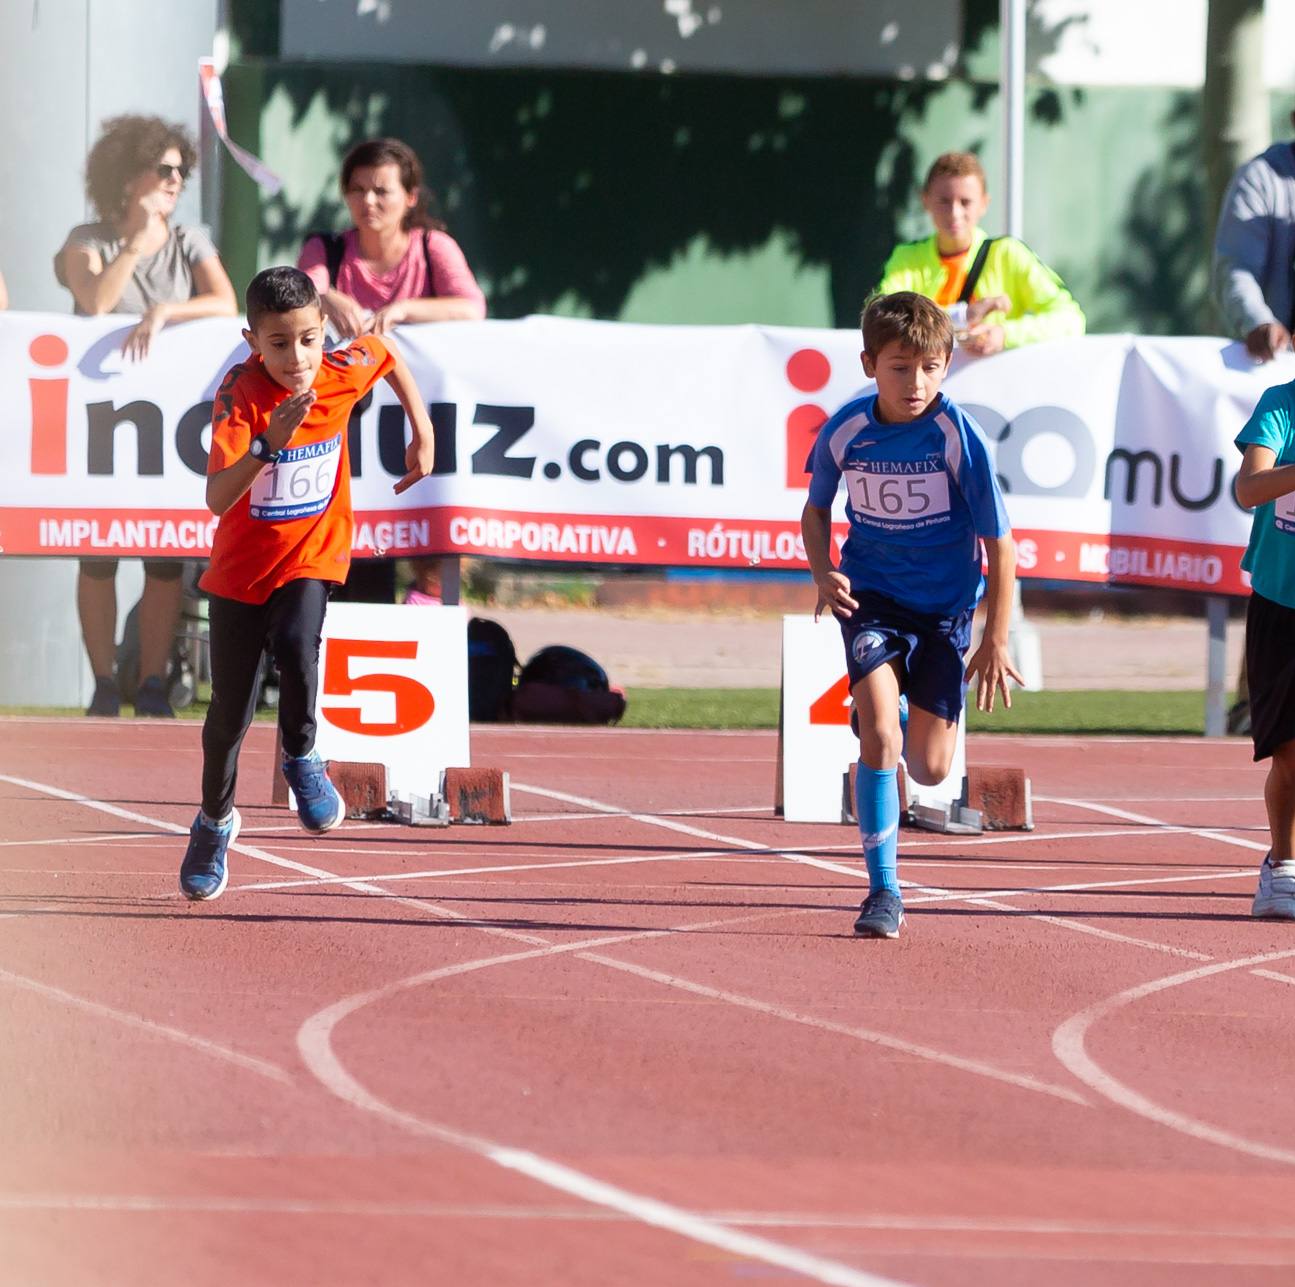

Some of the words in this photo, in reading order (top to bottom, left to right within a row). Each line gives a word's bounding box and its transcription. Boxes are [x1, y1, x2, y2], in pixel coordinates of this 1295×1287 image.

[261, 457, 334, 502] 166
[871, 460, 940, 474] HEMAFIX
[856, 476, 931, 515] 165
[449, 516, 637, 556] CORPORATIVA
[1079, 543, 1223, 585] MOBILIARIO
[322, 638, 435, 737] 5
